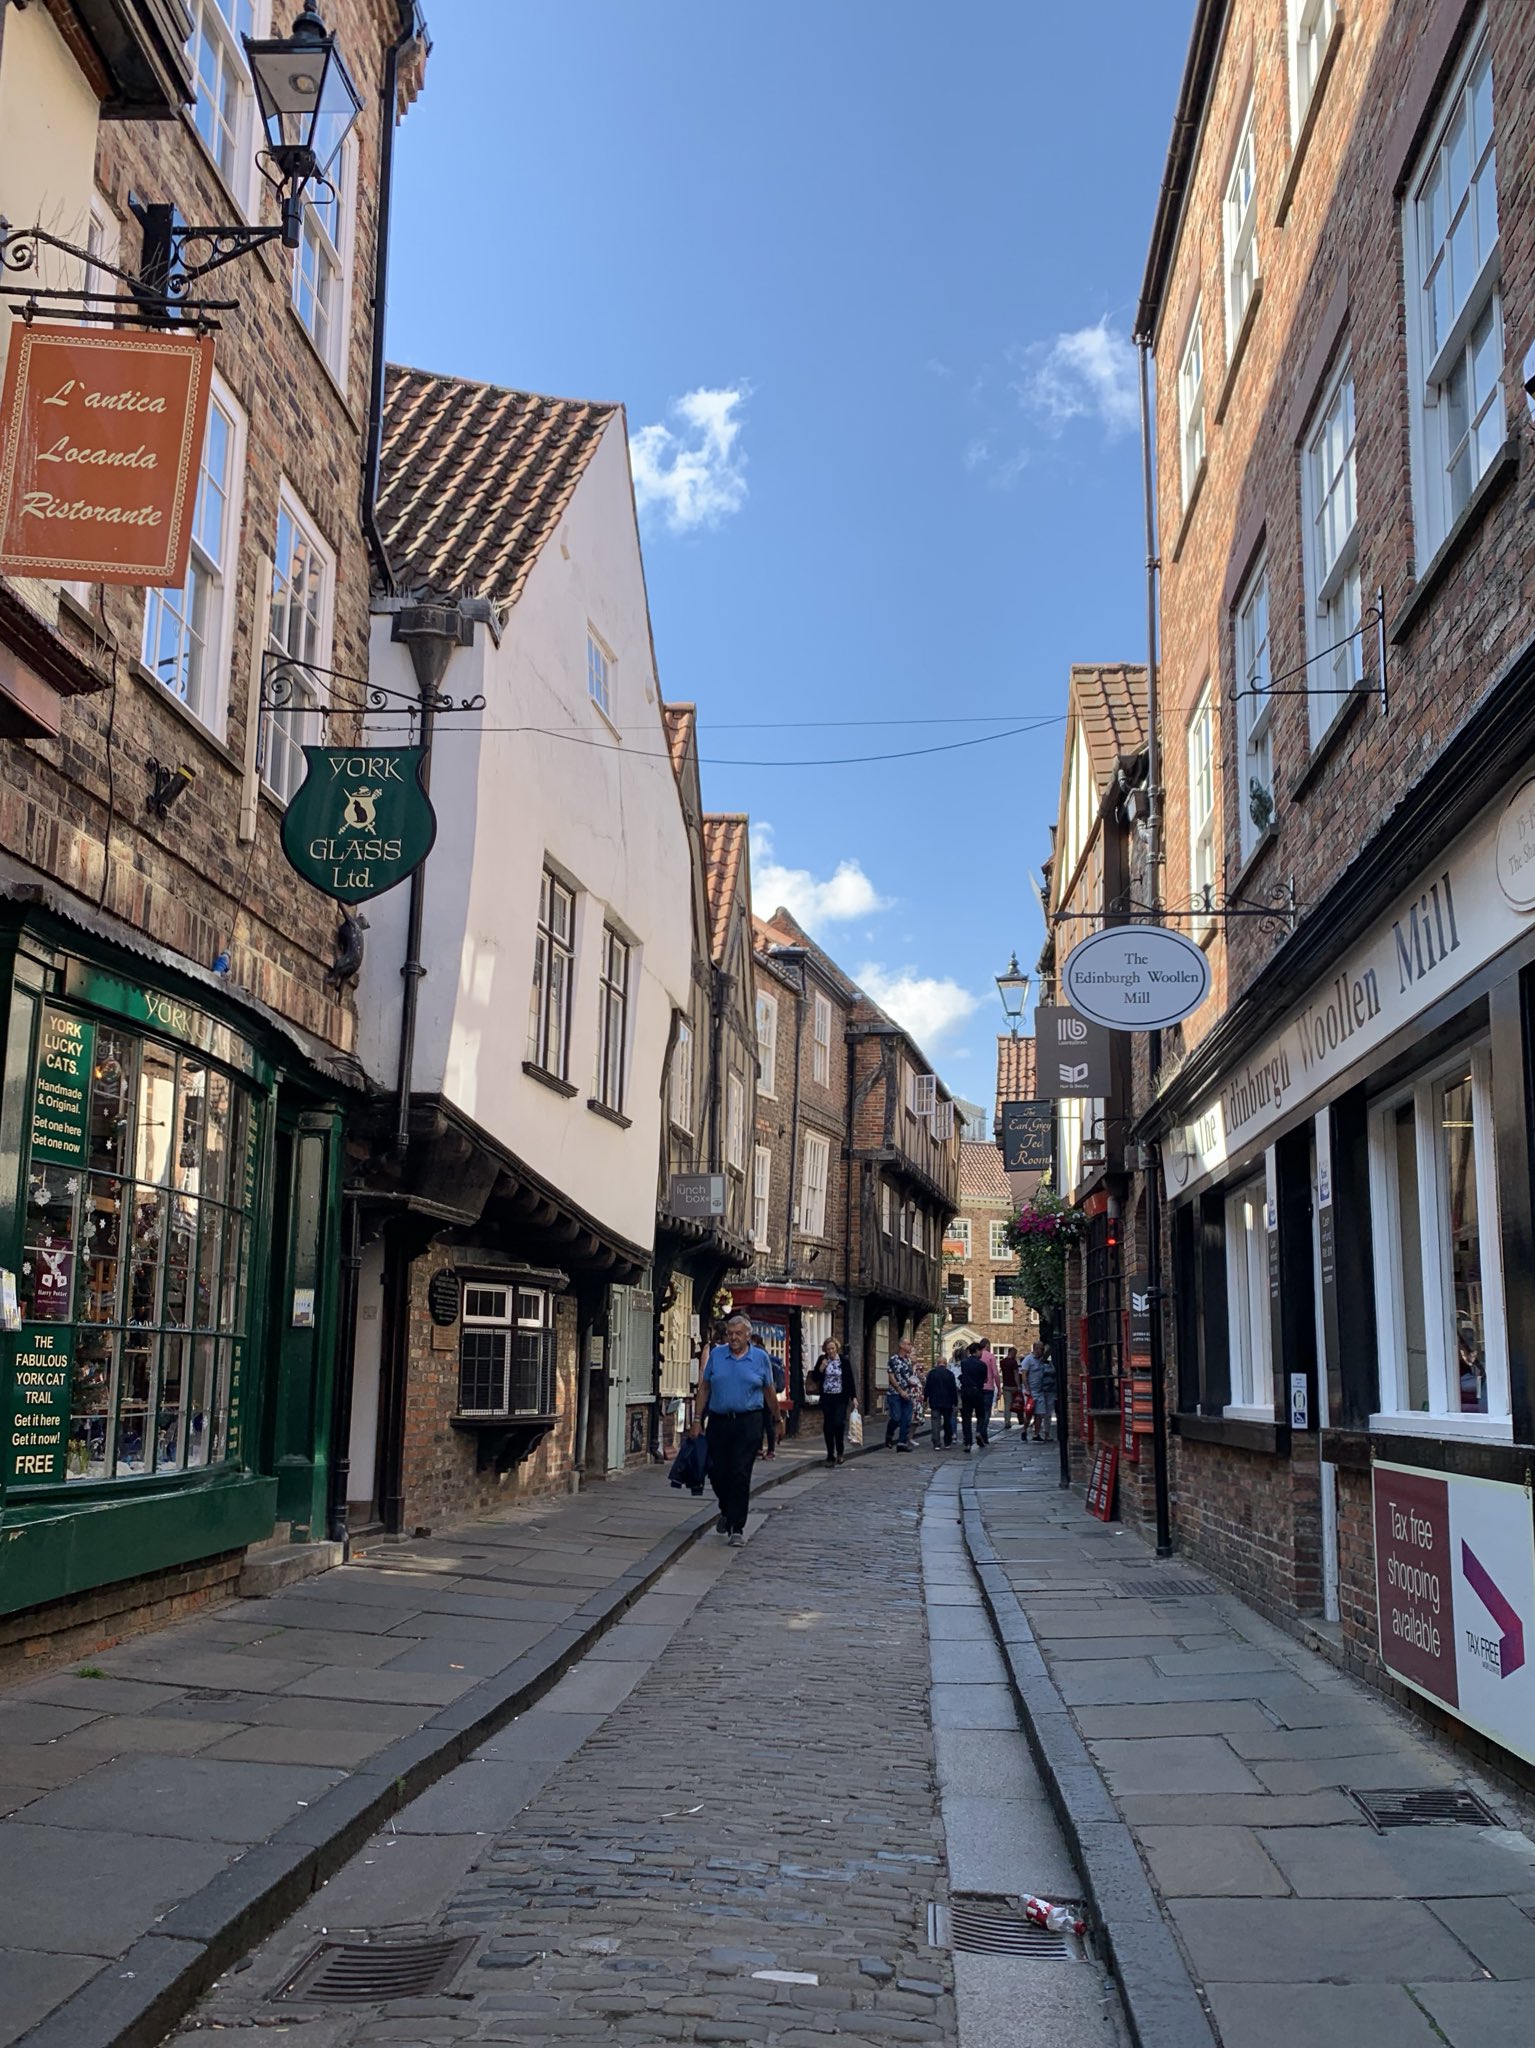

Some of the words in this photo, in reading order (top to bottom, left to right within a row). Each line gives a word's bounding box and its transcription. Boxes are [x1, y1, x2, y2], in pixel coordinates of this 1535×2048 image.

[37, 436, 158, 469] Locanda
[20, 491, 162, 526] Ristorante
[328, 757, 404, 782] YORK
[310, 838, 402, 863] GLASS
[1508, 855, 1522, 876] The
[332, 867, 374, 888] Ltd.
[1124, 953, 1148, 965] The
[1075, 972, 1140, 986] Edinburgh
[1147, 971, 1199, 983] Woollen
[1124, 992, 1150, 1004] Mill
[144, 993, 195, 1043] YORK
[1197, 1109, 1217, 1156] The
[1220, 1038, 1291, 1138] Edinburgh
[1295, 967, 1381, 1073] Woollen
[1392, 871, 1461, 994] Mill
[50, 1015, 82, 1039] YORK
[44, 1033, 84, 1057] LUCKY
[46, 1053, 80, 1076] CATS.
[38, 1078, 83, 1100] Handmade
[38, 1093, 45, 1105] &
[46, 1096, 81, 1115] Original.
[33, 1115, 48, 1128] Get
[48, 1120, 64, 1132] one
[64, 1124, 82, 1137] here
[1009, 1118, 1030, 1131] Earl
[1028, 1118, 1051, 1133] Grey
[32, 1133, 46, 1146] Get
[48, 1138, 62, 1149] one
[63, 1142, 80, 1153] now
[1020, 1133, 1043, 1148] Tea
[685, 1194, 705, 1203] box
[34, 1335, 54, 1349] THE
[15, 1354, 68, 1368] FABULOUS
[16, 1373, 45, 1386] YORK
[46, 1373, 66, 1386] CAT
[25, 1391, 54, 1404] TRAIL
[14, 1414, 31, 1427] Get
[32, 1413, 39, 1426] it
[40, 1414, 61, 1426] here
[12, 1433, 29, 1446] Get
[30, 1432, 37, 1445] it
[38, 1431, 61, 1445] now!
[15, 1454, 54, 1475] FREE
[1389, 1502, 1408, 1542] Tax
[1410, 1508, 1433, 1550] free
[1388, 1551, 1440, 1615] shopping
[1392, 1607, 1441, 1658] available
[1465, 1630, 1480, 1657] TAX
[1480, 1637, 1500, 1667] FREE
